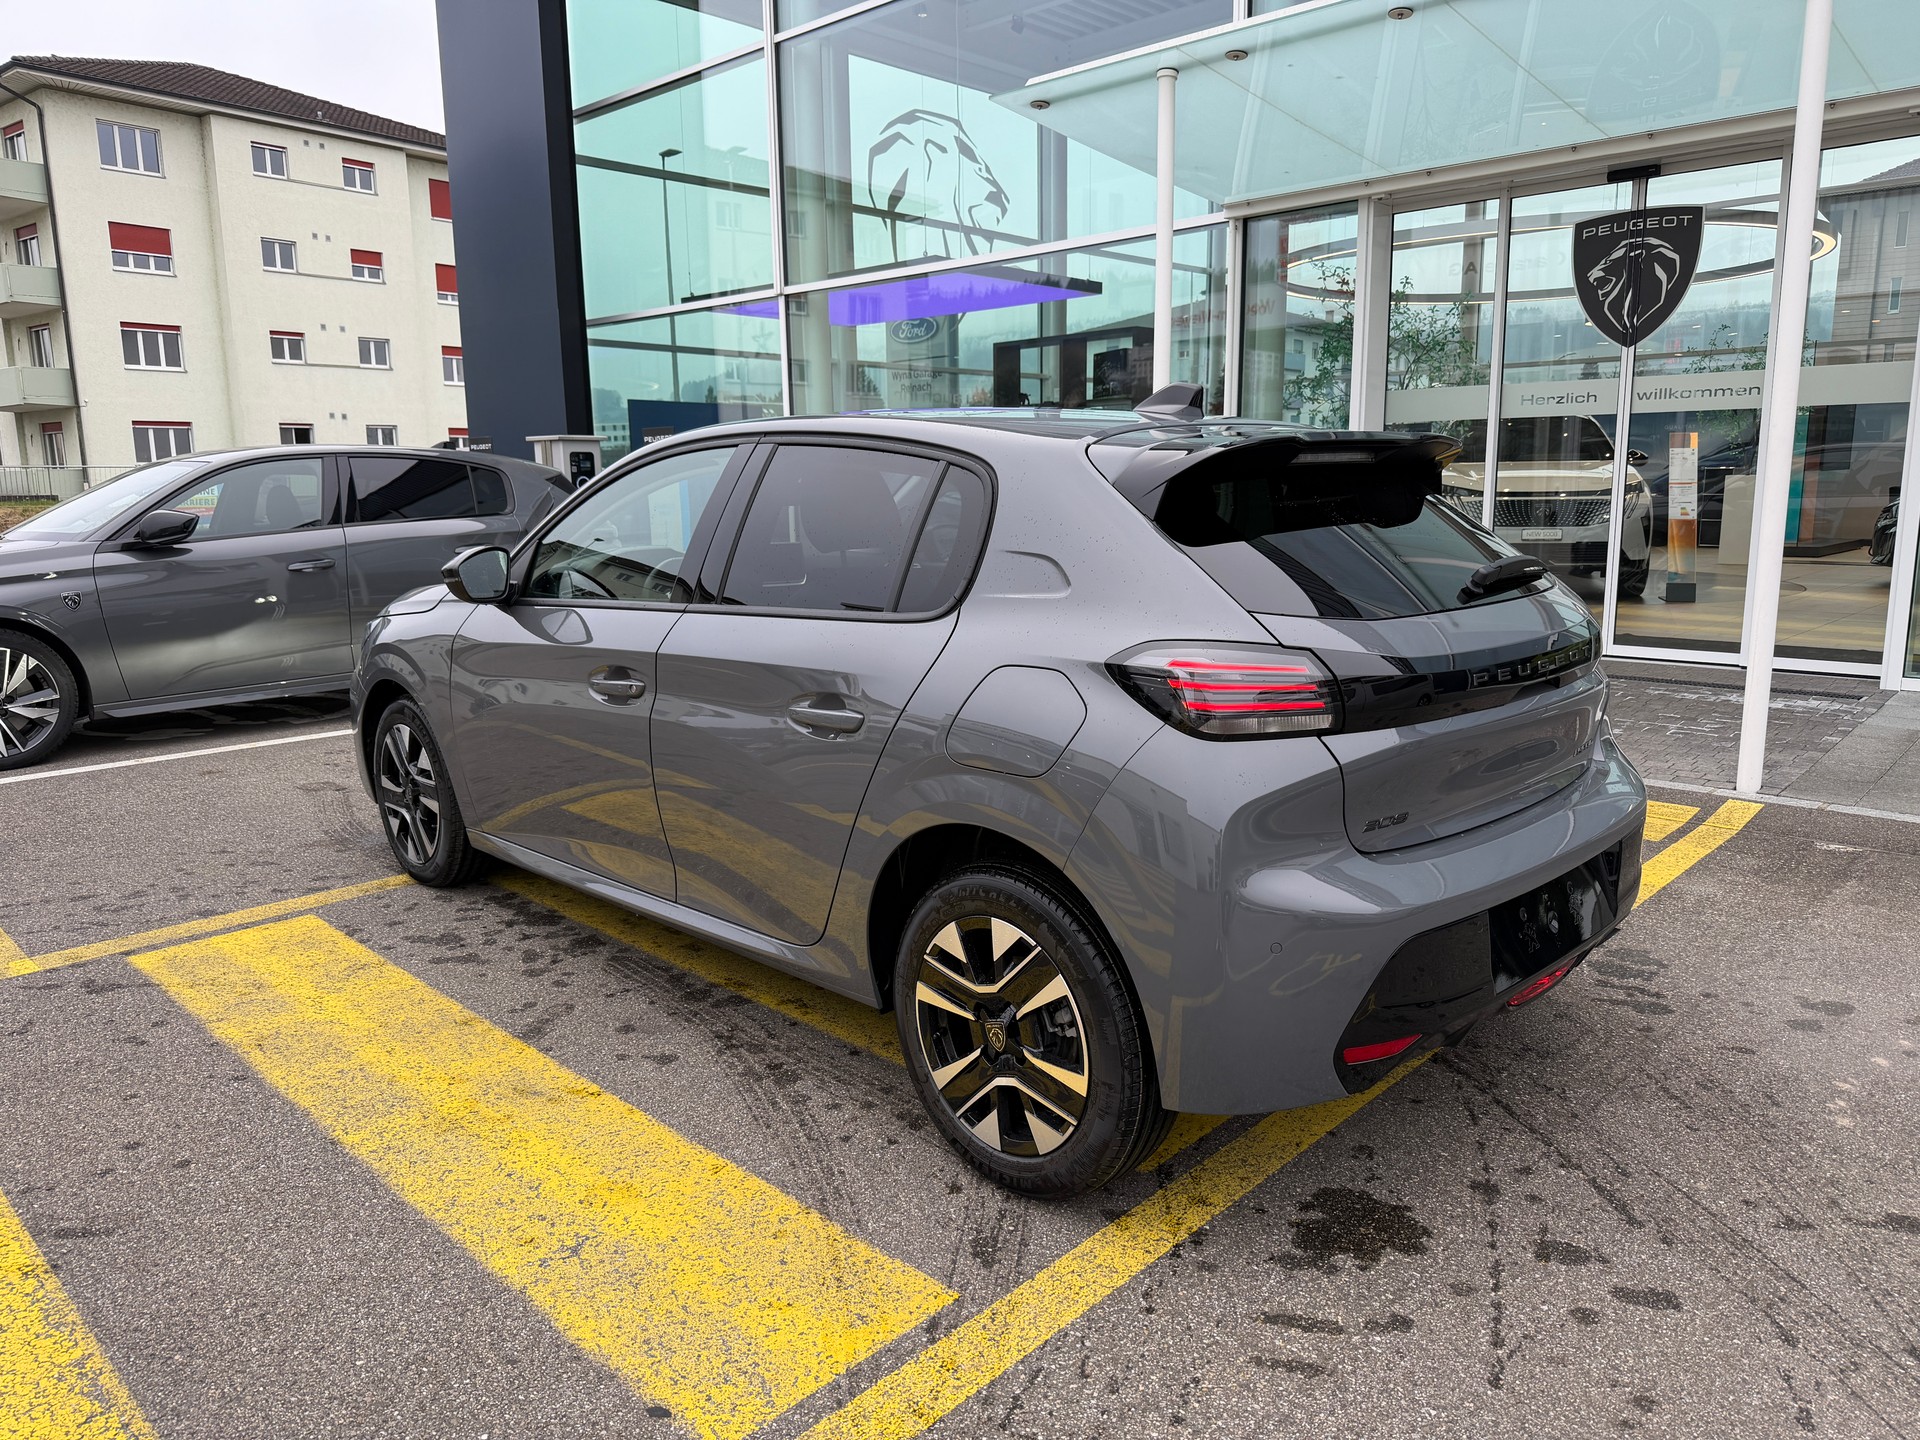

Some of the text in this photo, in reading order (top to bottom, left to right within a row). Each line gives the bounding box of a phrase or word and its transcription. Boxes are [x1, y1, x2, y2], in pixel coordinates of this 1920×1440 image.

[1582, 215, 1693, 240] PEUGEOT
[898, 319, 928, 339] Ford
[891, 369, 943, 382] Wyna Garage
[1520, 384, 1761, 406] Herzlich willkommen
[1473, 645, 1591, 687] PEUGEOT
[1361, 811, 1410, 834] 208
